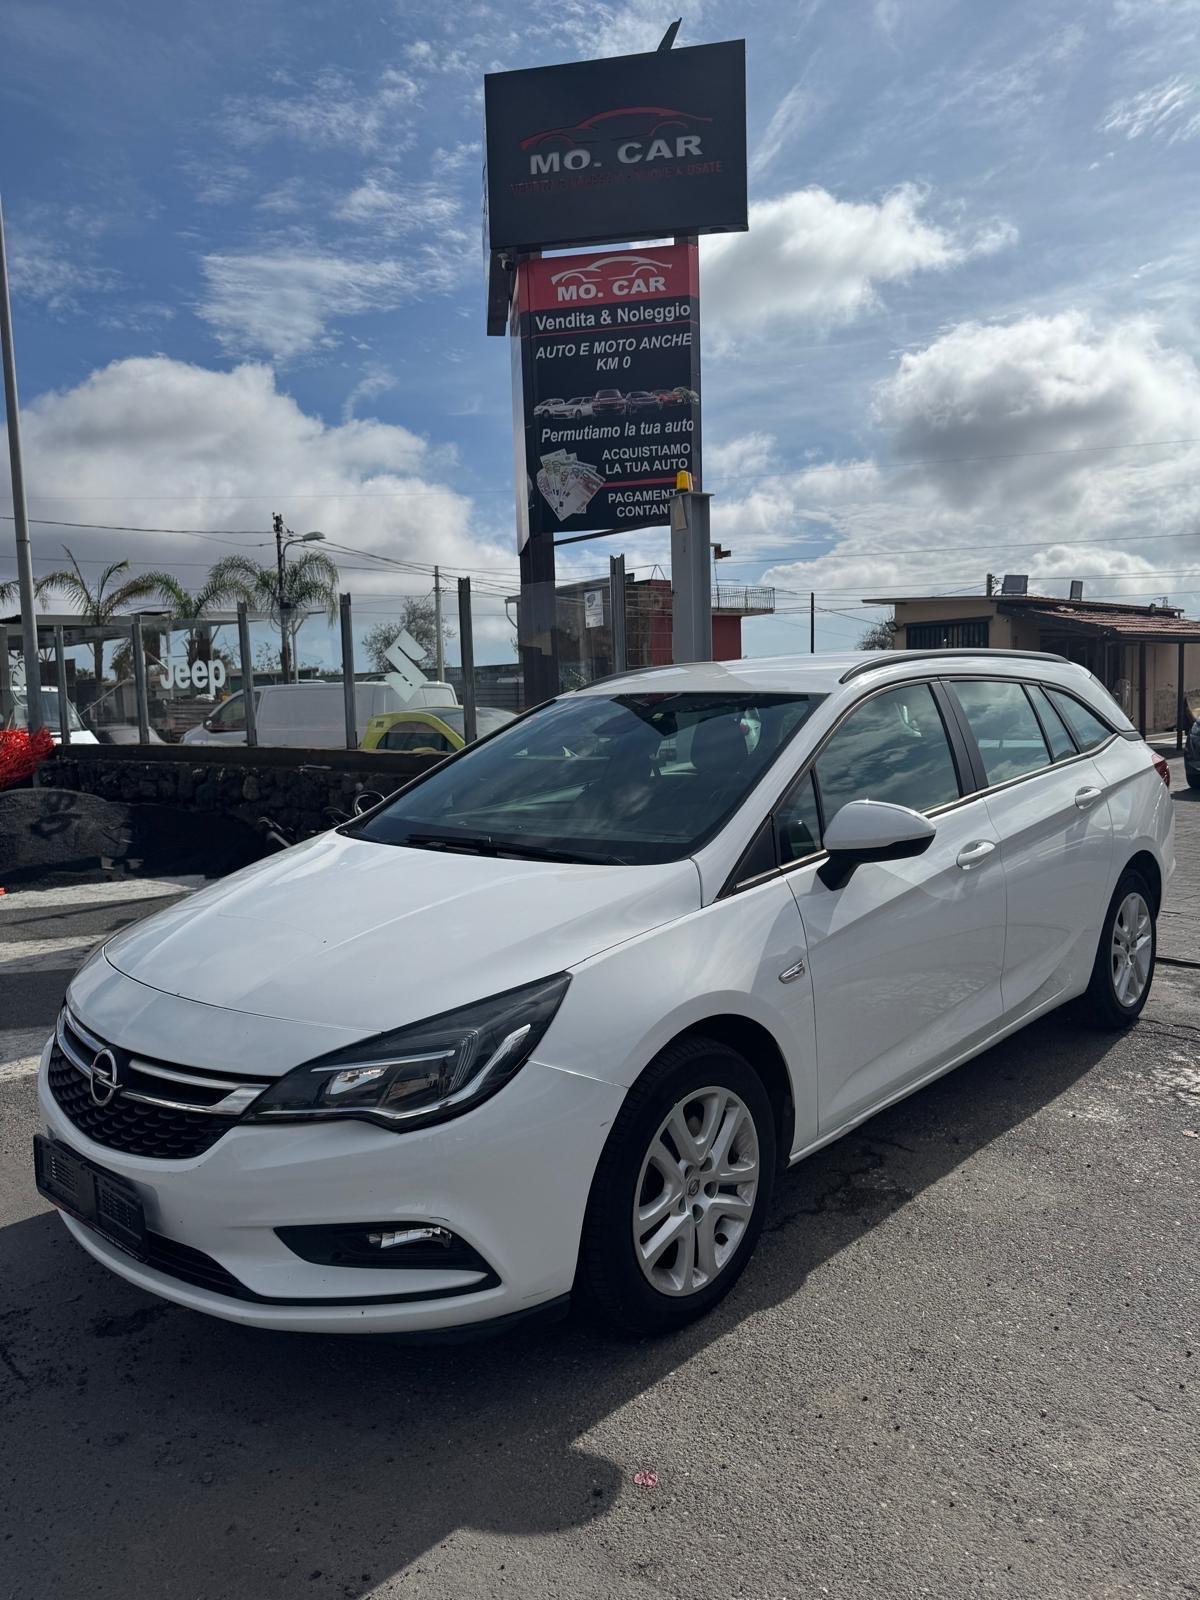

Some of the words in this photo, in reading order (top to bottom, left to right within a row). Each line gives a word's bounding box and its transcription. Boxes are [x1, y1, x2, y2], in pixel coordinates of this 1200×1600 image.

[529, 149, 602, 175] MO.
[617, 135, 703, 164] CAR
[557, 284, 604, 302] MO.
[612, 276, 667, 296] CAR
[535, 311, 595, 331] Vendita
[600, 309, 612, 325] &
[617, 302, 691, 323] Noleggio
[535, 345, 576, 360] AUTO
[579, 342, 590, 355] E
[592, 338, 637, 355] MOTO
[639, 332, 692, 350] ANCHE
[596, 357, 619, 371] KM
[541, 425, 621, 443] Permutiamo
[624, 422, 636, 437] la
[640, 422, 661, 436] tua
[664, 418, 695, 433] auto
[601, 443, 691, 462] ACQUISTIAMO
[605, 463, 623, 475] LA
[624, 460, 651, 474] TUA
[652, 458, 689, 472] AUTO
[608, 489, 677, 504] PAGAMENT
[160, 655, 226, 696] Jeep
